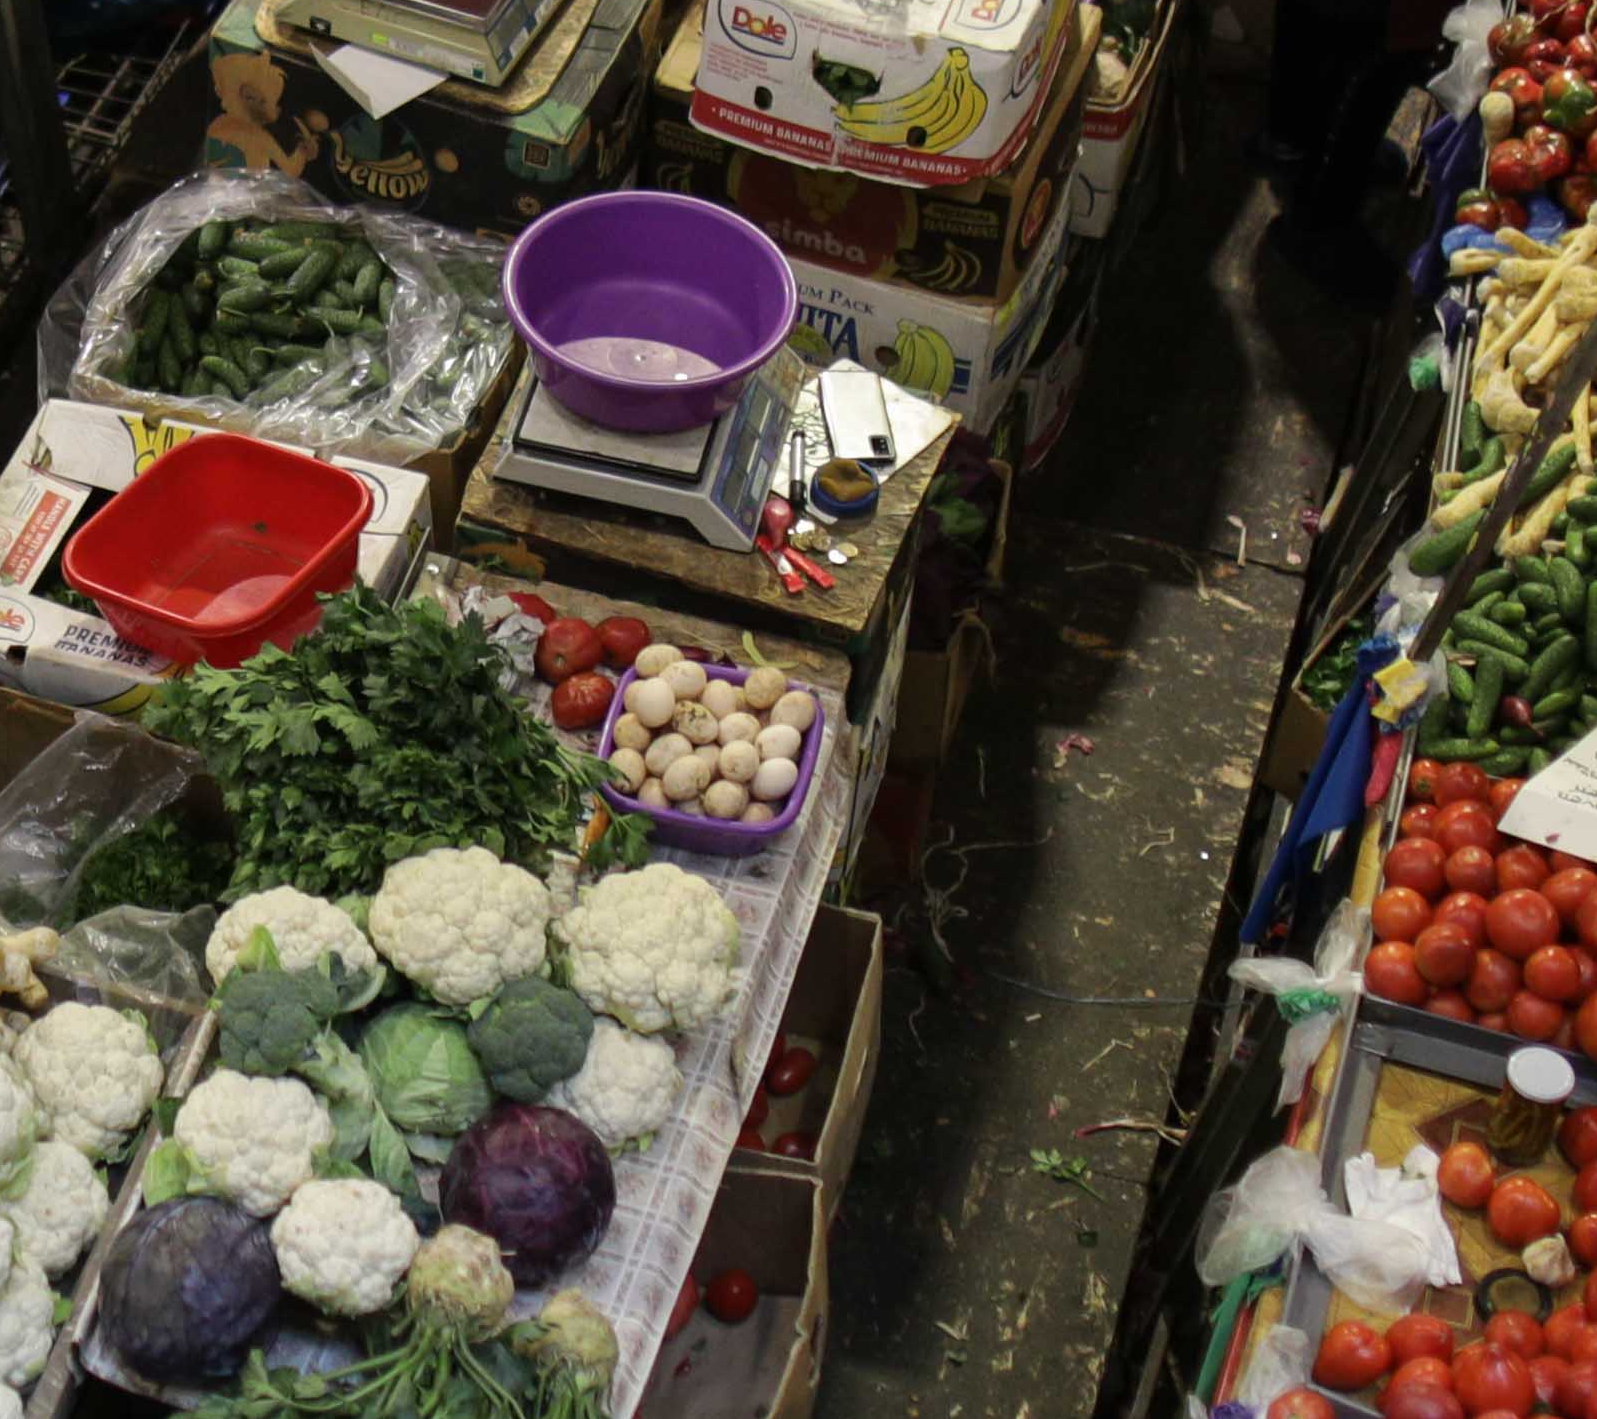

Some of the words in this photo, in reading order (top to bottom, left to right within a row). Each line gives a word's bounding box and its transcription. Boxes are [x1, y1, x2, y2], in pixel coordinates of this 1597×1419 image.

[731, 6, 789, 44] Dole
[717, 108, 775, 137] PREMIUM
[776, 125, 832, 153] BANANAS
[838, 141, 901, 167] PREMIUM
[902, 155, 964, 177] BANANAS
[825, 287, 877, 316] PACK
